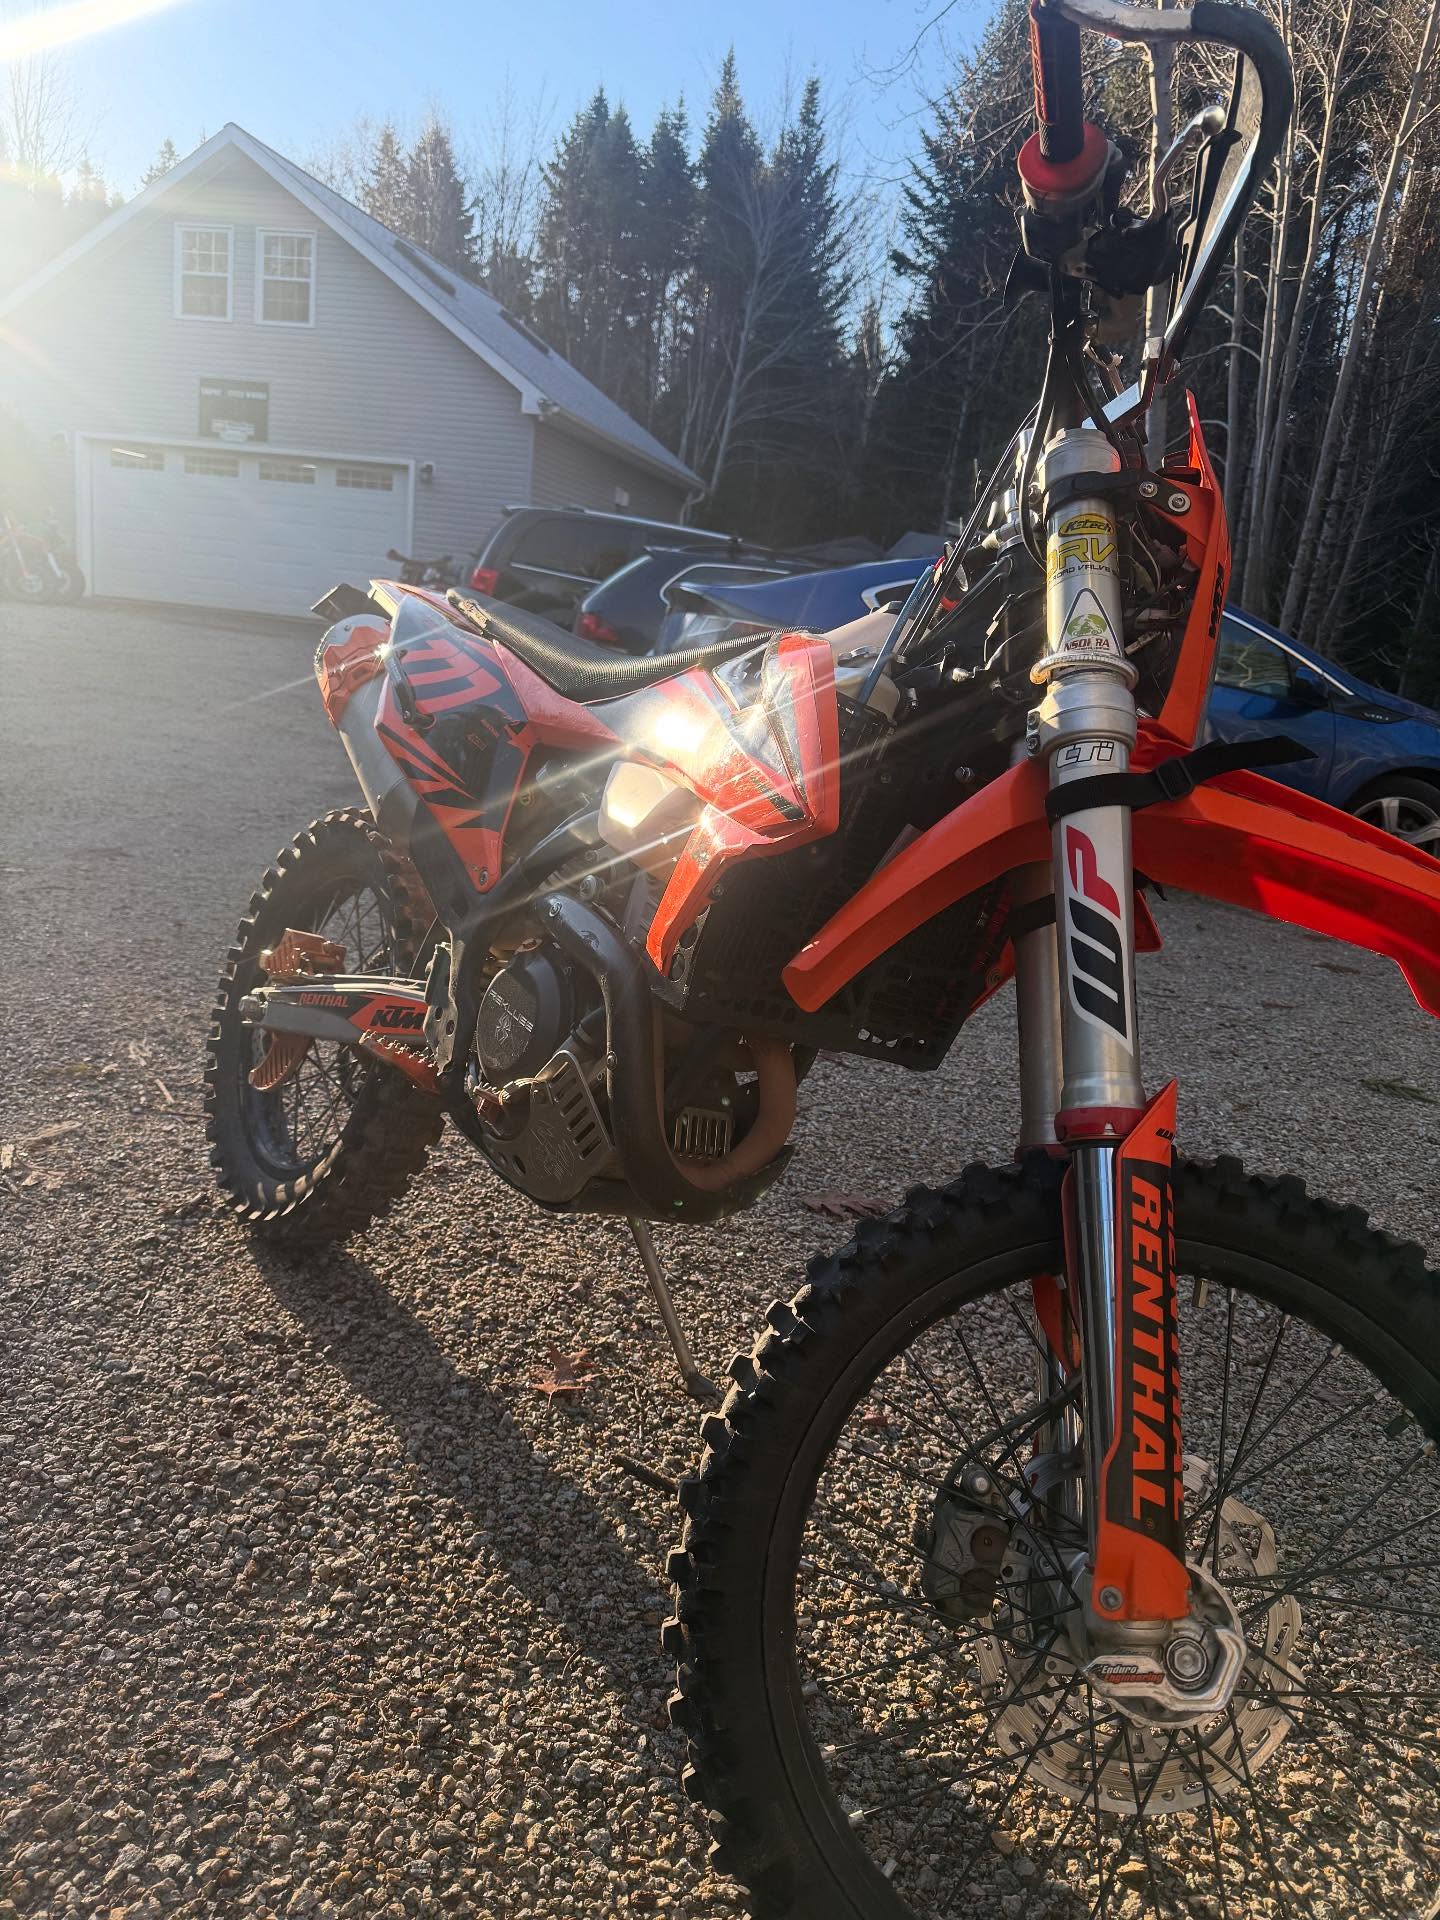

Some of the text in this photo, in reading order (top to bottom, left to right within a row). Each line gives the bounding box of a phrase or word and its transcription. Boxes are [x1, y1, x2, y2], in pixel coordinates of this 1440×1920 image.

[299, 993, 349, 1008] RENTHAL
[370, 1005, 425, 1030] KTM
[1131, 1175, 1165, 1520] RENTHAL
[1101, 1664, 1138, 1674] Enduro
